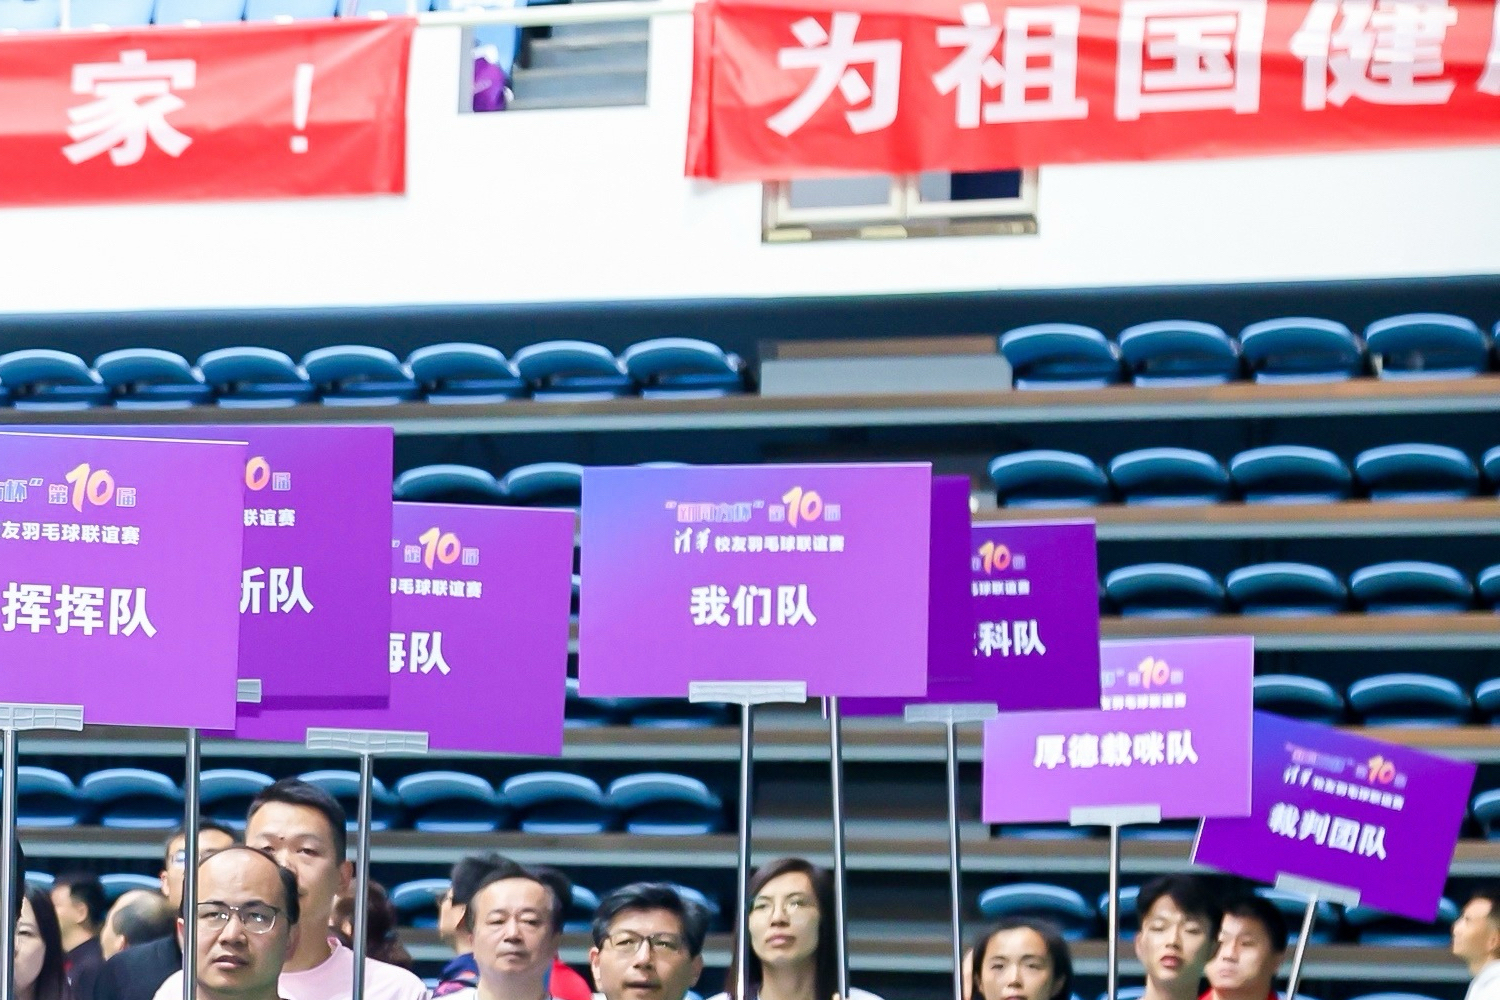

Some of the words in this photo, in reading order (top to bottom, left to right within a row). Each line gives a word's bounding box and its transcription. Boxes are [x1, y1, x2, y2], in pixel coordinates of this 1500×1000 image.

[690, 584, 817, 627] 我们队
[974, 619, 1046, 657] 科队
[1267, 802, 1386, 860] 裁判团队
